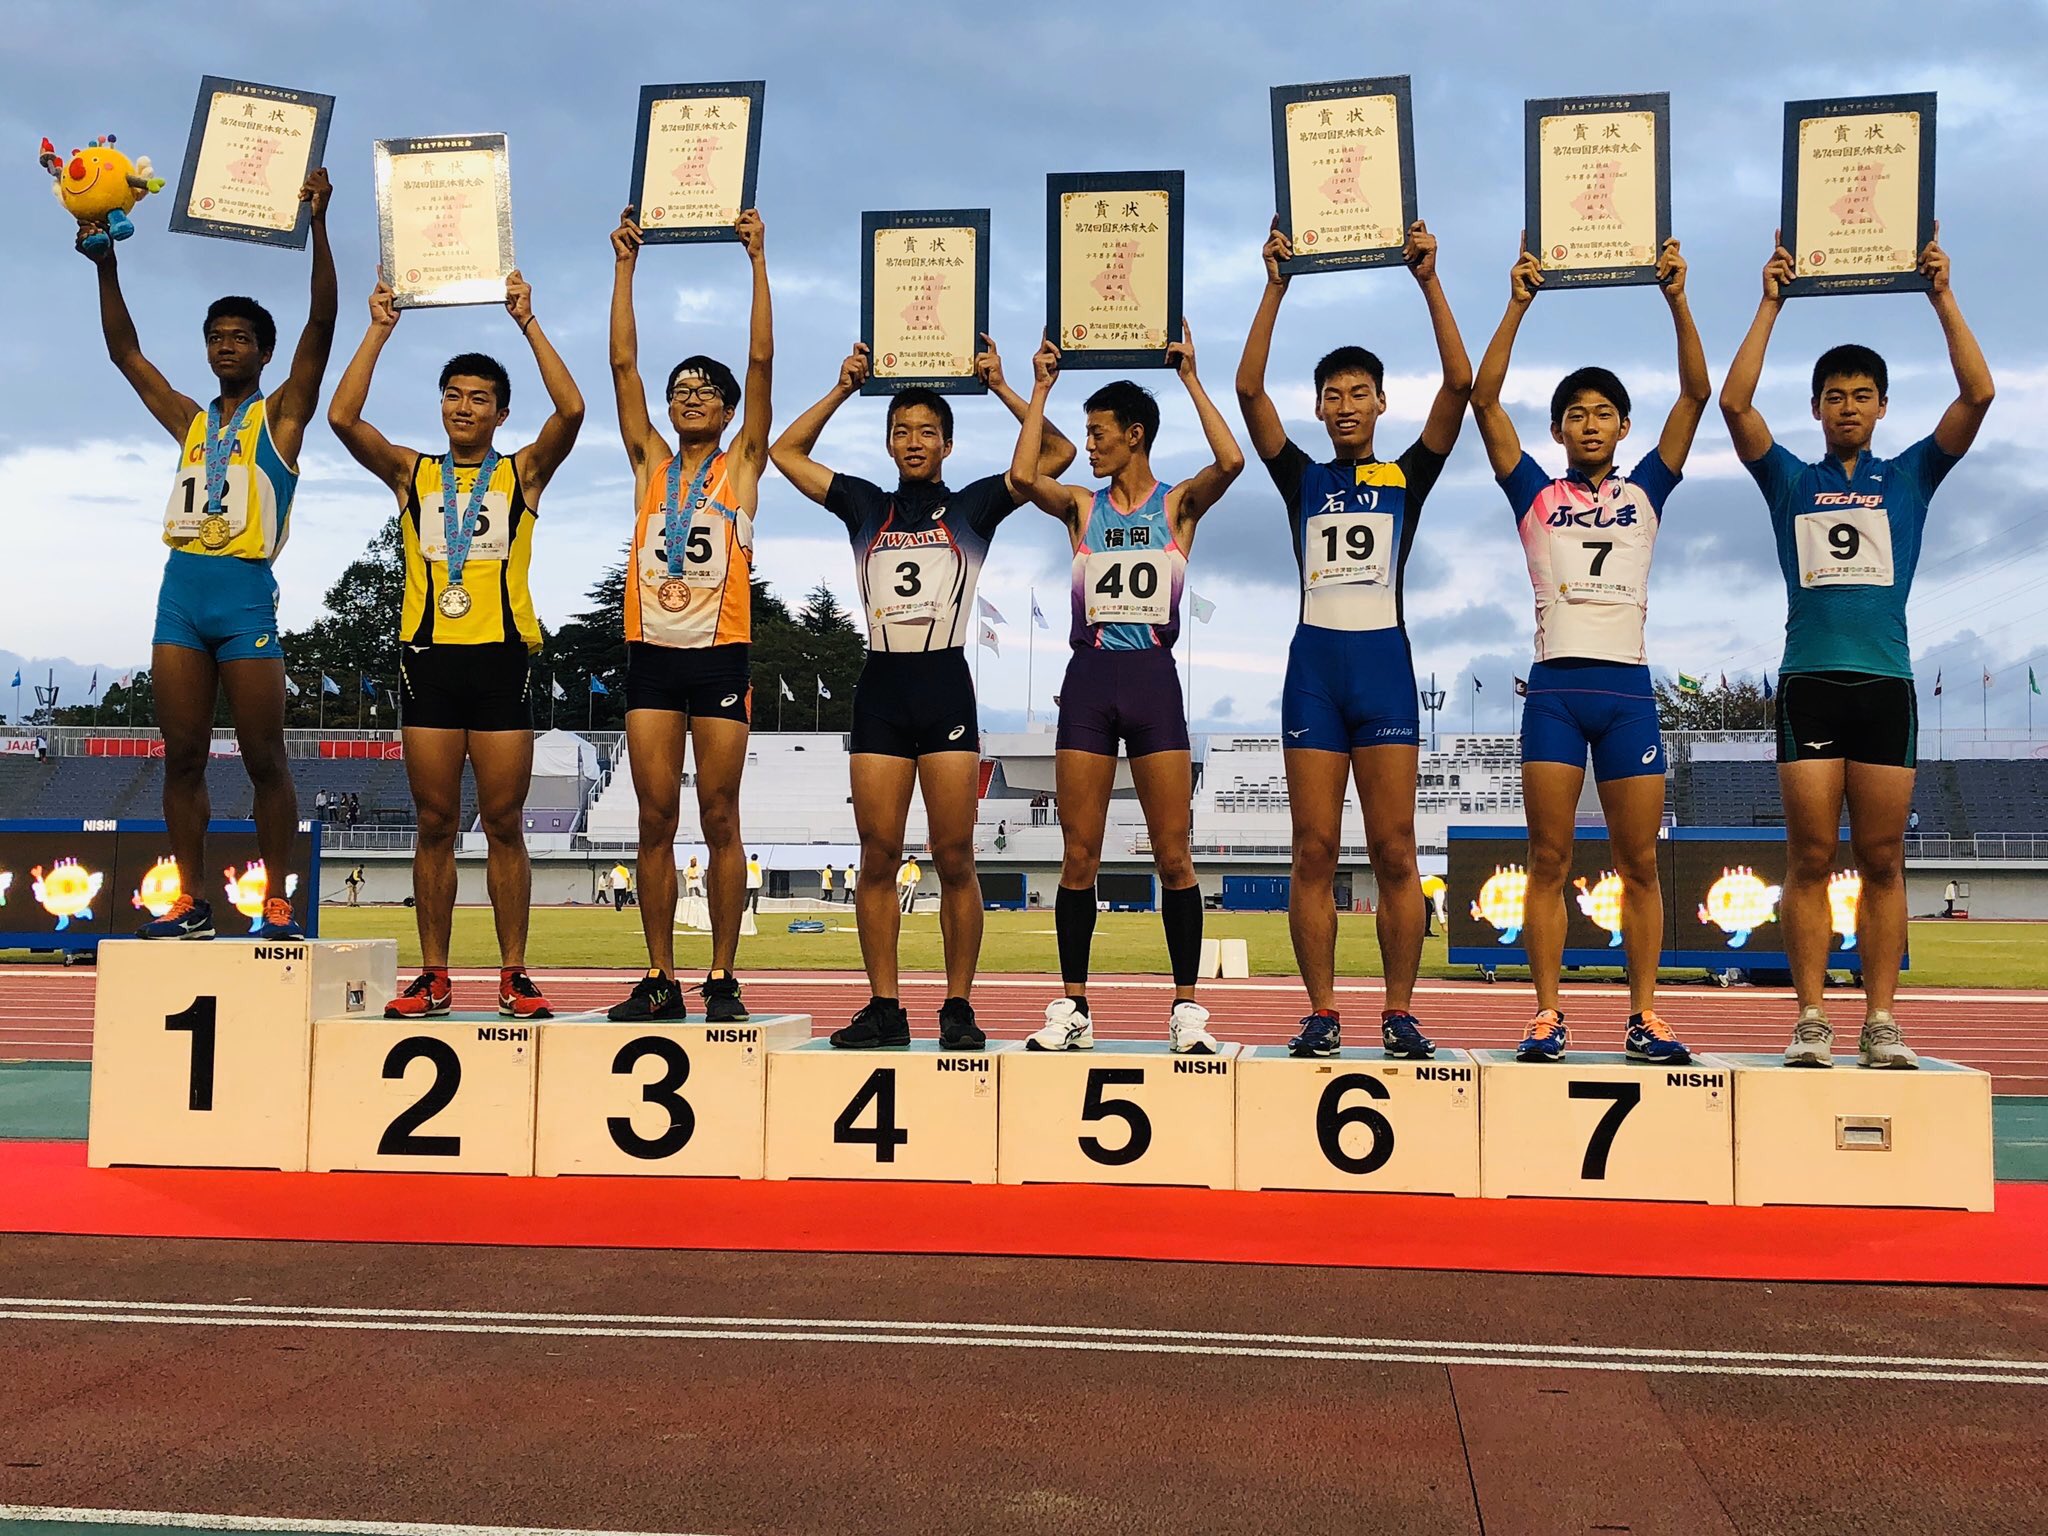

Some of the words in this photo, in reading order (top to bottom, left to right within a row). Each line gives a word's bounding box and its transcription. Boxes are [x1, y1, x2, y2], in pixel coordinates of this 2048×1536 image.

[1318, 108, 1365, 126] 賞状
[660, 121, 738, 132] 第74回国民体育大会
[1300, 126, 1385, 142] 第74回国民体育大会
[1573, 123, 1621, 141] 賞状
[1834, 123, 1885, 143] 賞状
[1553, 142, 1642, 156] 第74回国民体育大会
[1812, 143, 1906, 160] 第74回国民体育大会
[1094, 200, 1140, 218] 賞状
[1076, 222, 1158, 233] 第74回国民体育大会
[904, 236, 946, 253] 賞状
[886, 256, 964, 268] 第74回国民体育大会
[1318, 490, 1379, 513] 石川
[1546, 504, 1638, 528] ふくしま
[872, 528, 950, 550] IWATE
[1104, 526, 1150, 548] 福岡
[1322, 525, 1374, 562] 19
[1828, 523, 1860, 560] 9
[1582, 542, 1613, 576] 7
[894, 562, 922, 598] 3
[1095, 562, 1158, 598] 40
[83, 820, 117, 831] NISHI
[254, 947, 304, 960] NISHI
[478, 1028, 528, 1042] NISHI
[706, 1029, 757, 1043] NISHI
[164, 996, 216, 1111] 1
[937, 1058, 989, 1072] NISHI
[1174, 1060, 1227, 1075] NISHI
[1416, 1067, 1471, 1082] NISHI
[1666, 1073, 1724, 1088] NISHI
[376, 1036, 462, 1156] 2
[606, 1036, 696, 1160] 3
[834, 1068, 908, 1162] 4
[1078, 1069, 1152, 1166] 5
[1316, 1073, 1394, 1175] 6
[1568, 1081, 1640, 1180] 7
